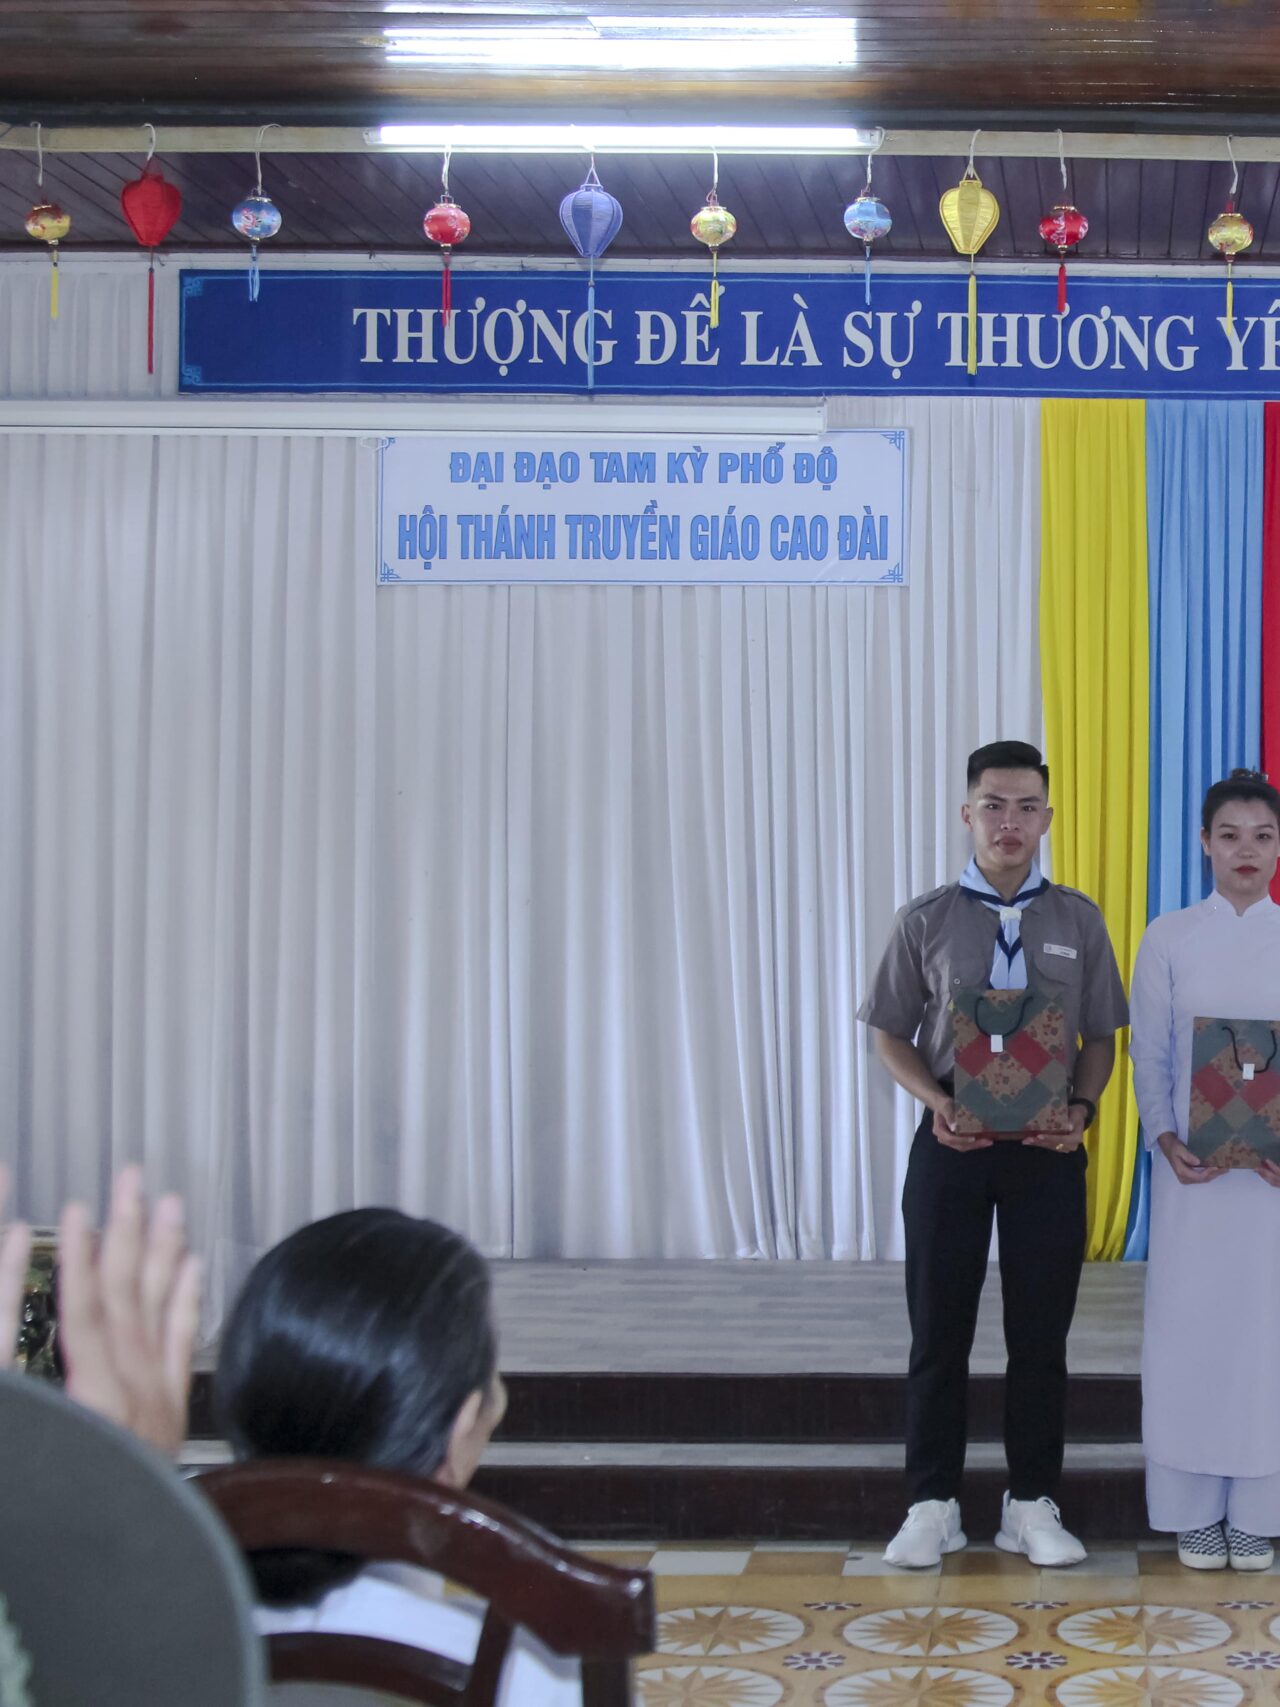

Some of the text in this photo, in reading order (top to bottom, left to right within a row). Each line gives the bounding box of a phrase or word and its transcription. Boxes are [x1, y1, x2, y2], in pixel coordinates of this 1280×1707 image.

[353, 297, 618, 377] THƯỢNG
[740, 293, 823, 367] LÀ
[843, 300, 922, 379] SỰ
[937, 305, 1199, 371] THƯƠNG
[449, 442, 837, 491] ĐẠI ĐẠO TAM KỲ PHỔ ĐỘ
[398, 500, 888, 570] HỘI THÁNH TRUYỀN GIÁO CAO ĐÀI
